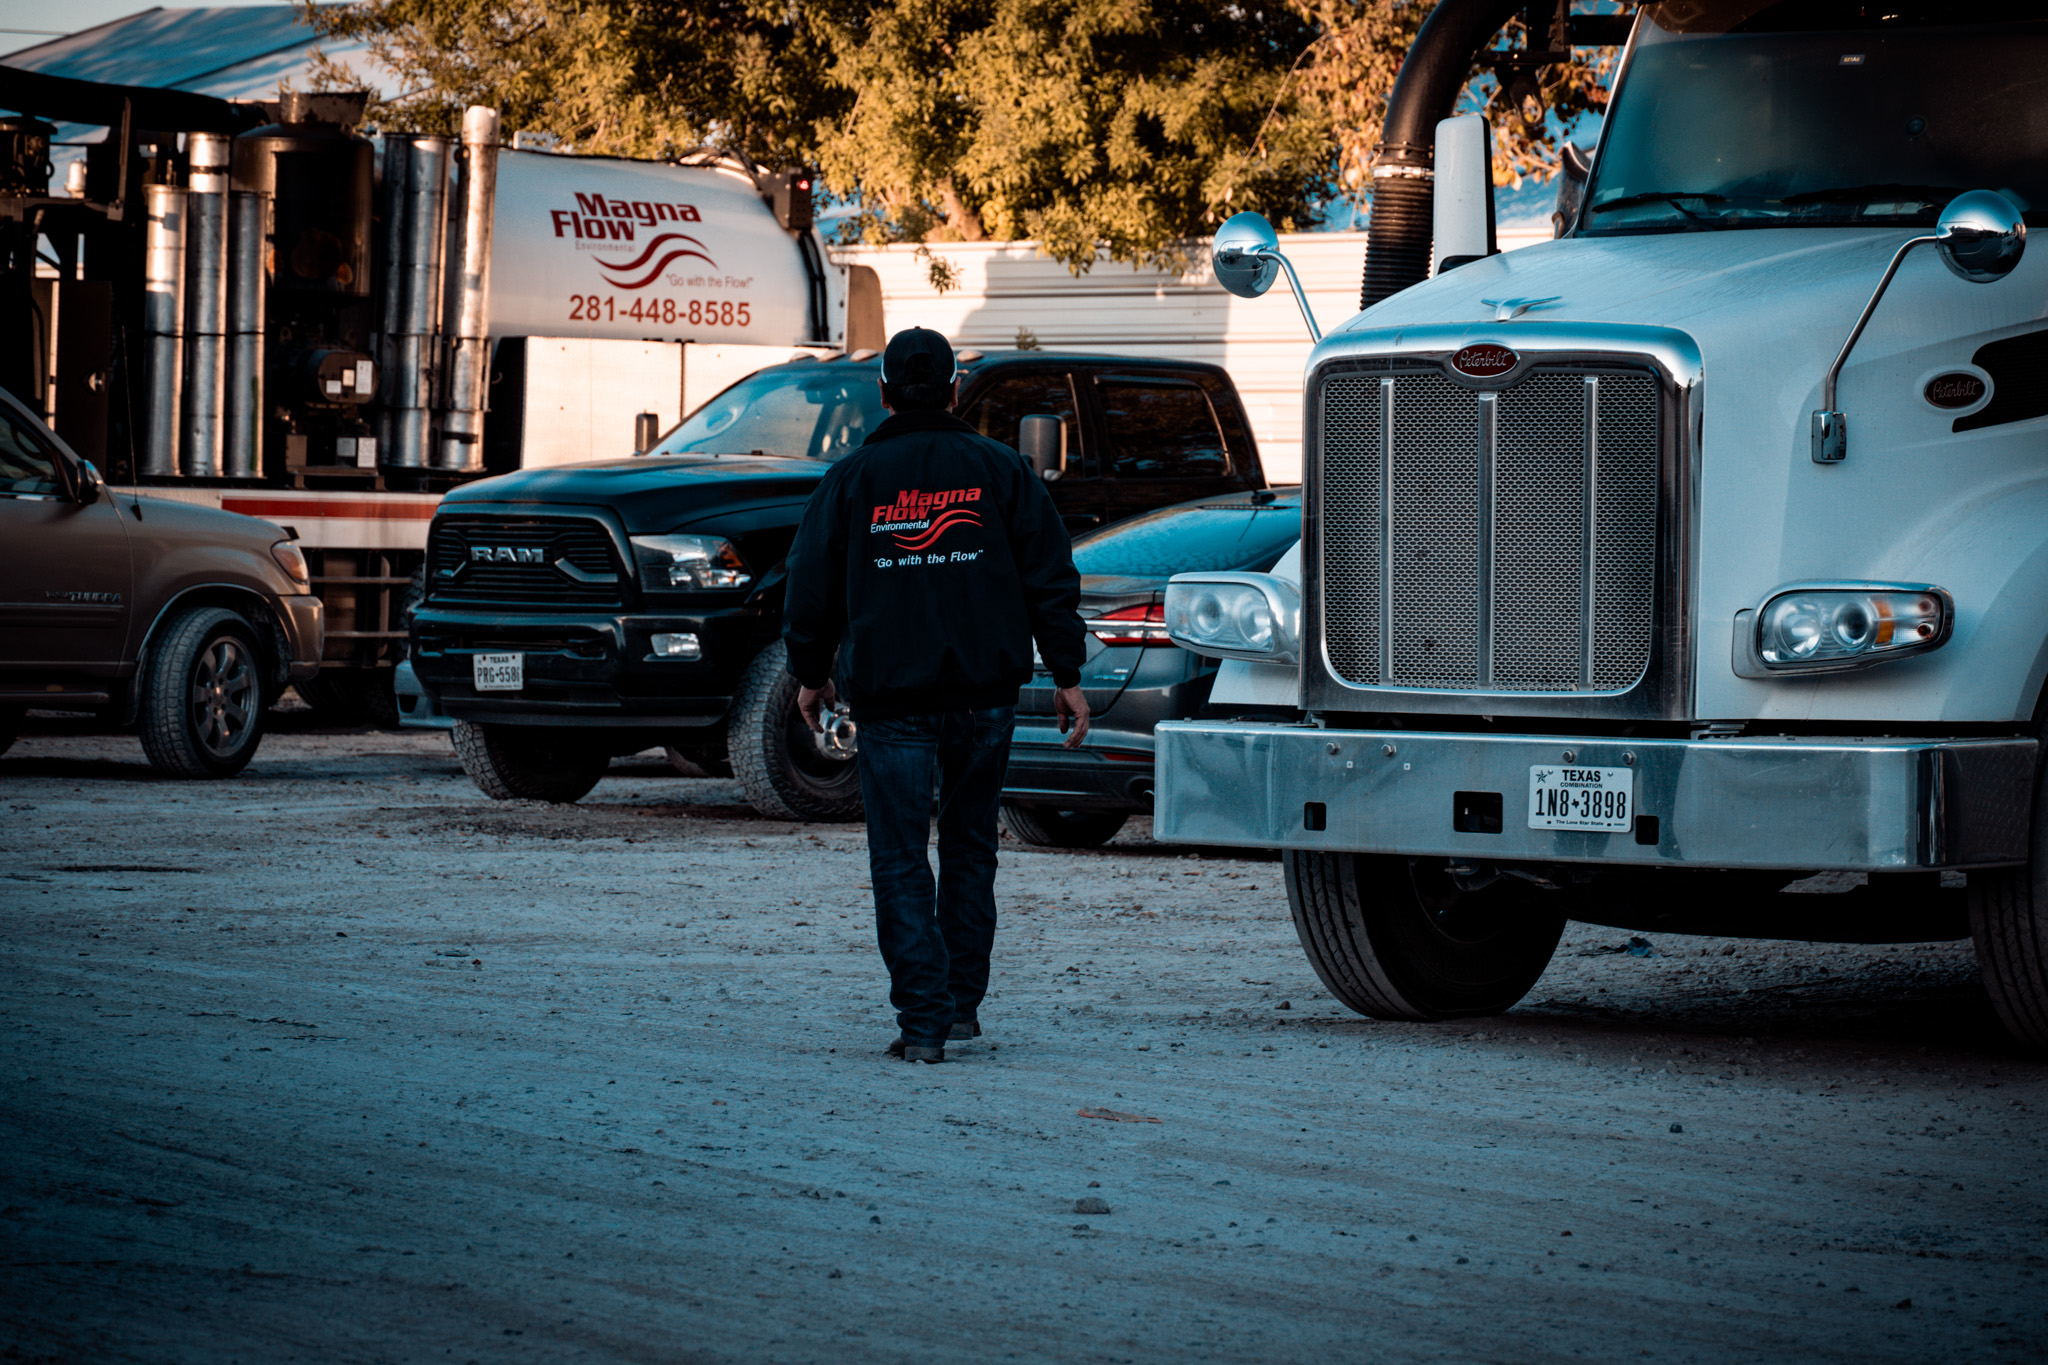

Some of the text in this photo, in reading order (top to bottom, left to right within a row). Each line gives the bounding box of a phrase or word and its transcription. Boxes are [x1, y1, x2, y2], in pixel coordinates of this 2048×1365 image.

[574, 192, 702, 227] Magna
[550, 209, 635, 241] Flow
[575, 240, 635, 252] Environmental
[687, 275, 705, 287] with
[707, 275, 723, 288] the
[568, 294, 751, 327] 281-448-8585
[1459, 350, 1512, 369] Peterbilt
[1932, 381, 1981, 401] Peterbilt
[896, 487, 982, 510] Magna
[872, 504, 931, 523] Flow
[870, 519, 930, 534] Environmental
[470, 547, 544, 563] RAM
[873, 549, 984, 568] "Go with the Flow"
[1562, 769, 1601, 782] TEXAS
